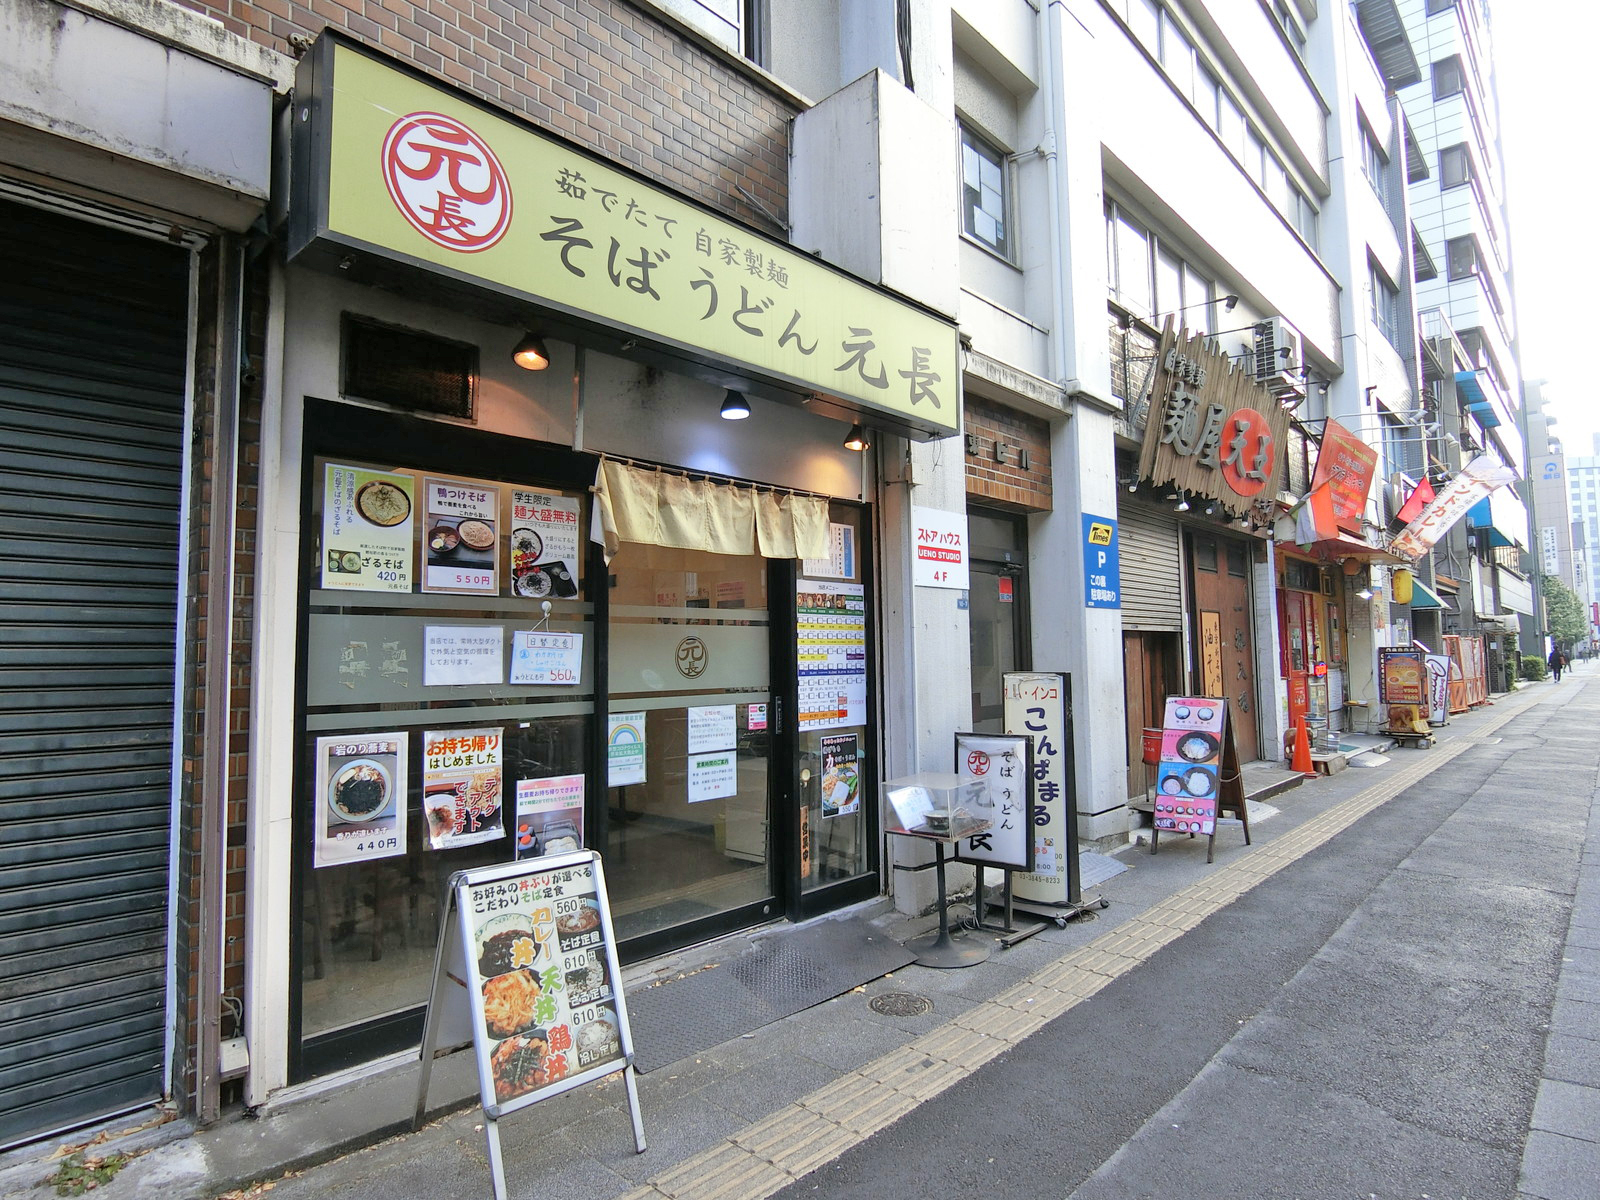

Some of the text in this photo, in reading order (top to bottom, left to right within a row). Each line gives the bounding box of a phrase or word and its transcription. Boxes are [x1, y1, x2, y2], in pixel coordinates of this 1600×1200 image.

[555, 168, 789, 290] 茹でたて 自家製麺
[540, 215, 943, 409] そば うどん 元長
[437, 487, 487, 503] 鴨つけそば
[514, 492, 552, 507] 学生限定
[514, 505, 577, 525] 麺大盛無料
[361, 558, 404, 570] ざるそば
[918, 549, 960, 561] UENO STUDIO
[1097, 551, 1107, 569] P
[1090, 588, 1117, 602] 駐車場あり
[429, 647, 495, 656] で外気と空気の循環を
[429, 658, 474, 666] しております。
[335, 741, 389, 756] 岩のり蕎麦
[426, 735, 499, 757] お持ち帰り
[429, 752, 497, 769] はじめました
[1025, 707, 1060, 827] こんぱまる
[454, 780, 469, 835] できます
[484, 778, 497, 818] テイク
[1000, 787, 1015, 830] うどん
[469, 792, 482, 832] アウト
[357, 838, 397, 852] 440円
[472, 867, 593, 901] お好みの丼ぶりが選べる
[474, 885, 564, 914] こだわりそば定食
[560, 929, 601, 952] そば定食
[534, 964, 564, 1025] 天丼
